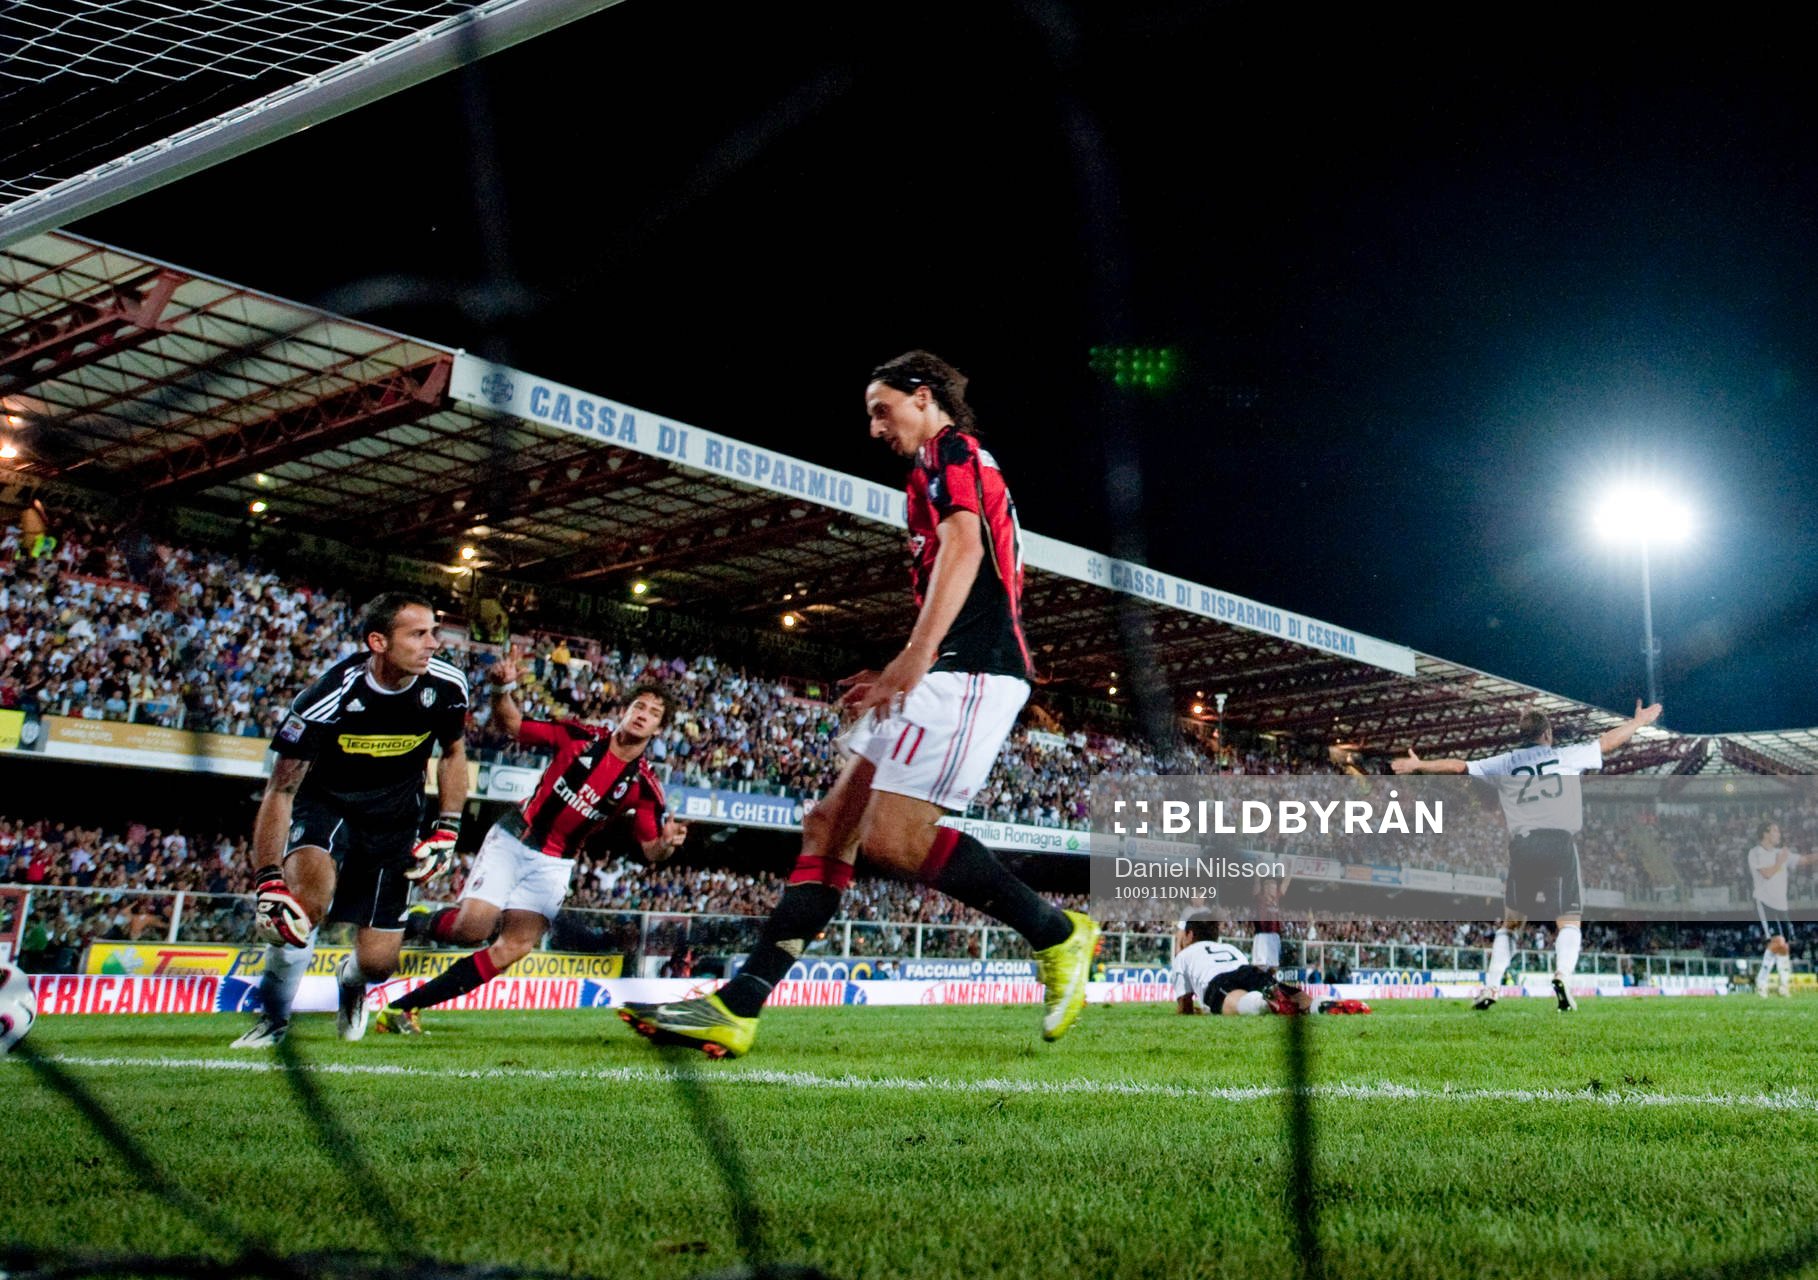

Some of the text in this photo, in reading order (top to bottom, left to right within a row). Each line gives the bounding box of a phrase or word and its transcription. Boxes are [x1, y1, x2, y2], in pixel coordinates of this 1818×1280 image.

[530, 384, 638, 445] CASSA
[657, 423, 688, 459] DI
[705, 437, 854, 508] RISPARMIO
[866, 488, 891, 518] DI
[1110, 561, 1357, 656] CASSA DI RISPARMIO DI CESENA
[892, 722, 925, 766] 11
[579, 783, 601, 805] Fly
[1511, 759, 1563, 805] 25
[731, 801, 791, 825] GHETTI
[1004, 826, 1062, 849] Romagna
[985, 961, 1032, 976] ACQUA
[28, 975, 218, 1014] ERICANINO
